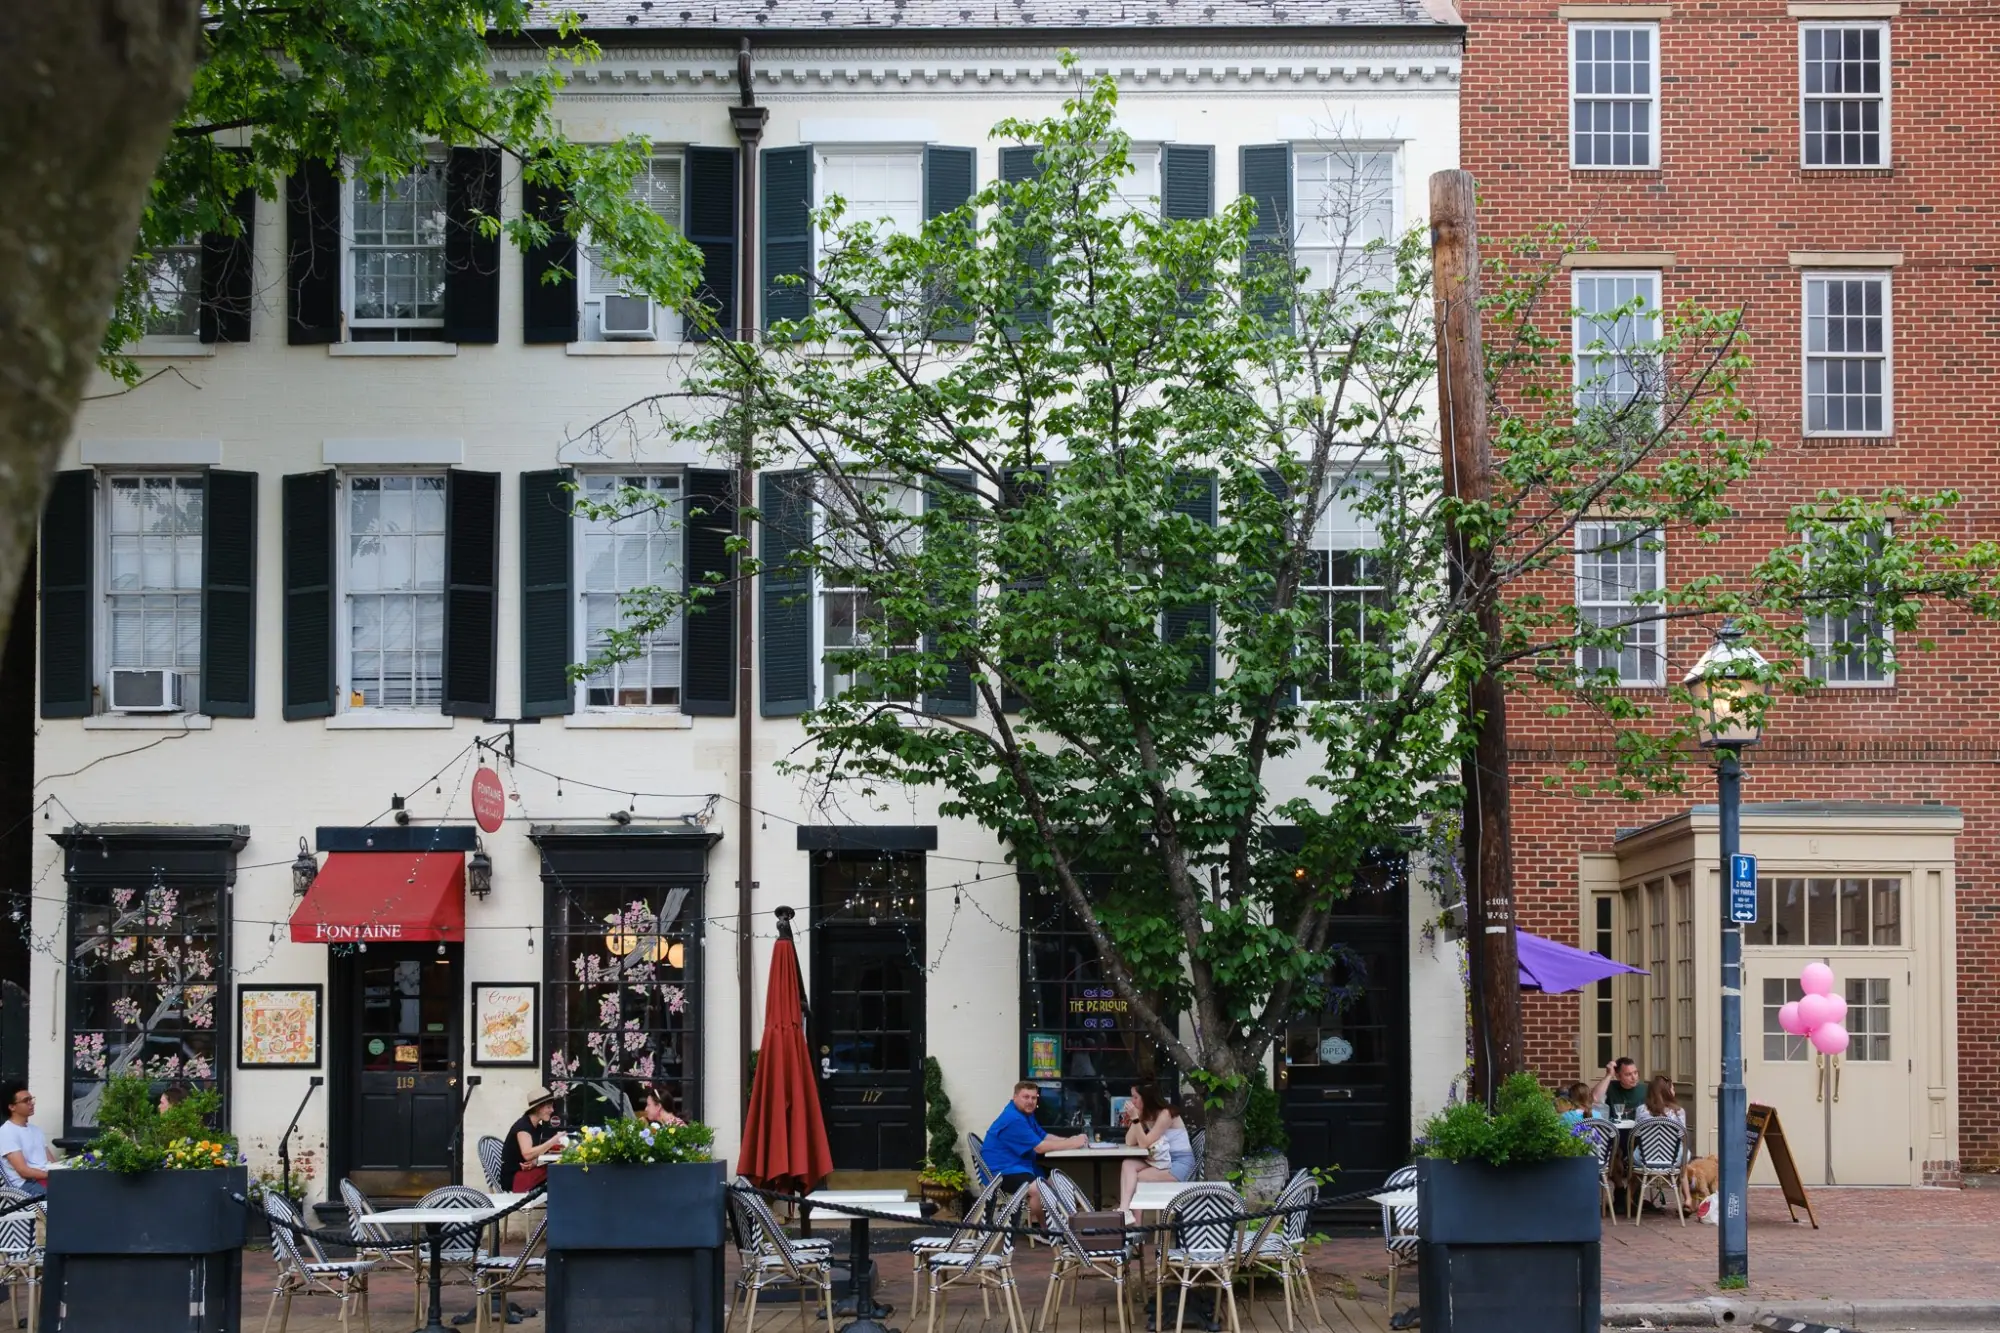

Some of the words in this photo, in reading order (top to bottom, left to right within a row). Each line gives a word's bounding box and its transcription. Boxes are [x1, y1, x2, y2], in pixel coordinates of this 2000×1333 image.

[477, 781, 502, 802] FONTAINE
[1740, 860, 1748, 878] P
[316, 923, 402, 938] FONTAINE
[487, 990, 524, 1005] Crepes
[1069, 1000, 1085, 1013] THE
[1086, 1000, 1128, 1013] PARLOUR
[1322, 1047, 1347, 1055] OPEN
[396, 1076, 415, 1089] 119
[862, 1090, 883, 1103] 117
